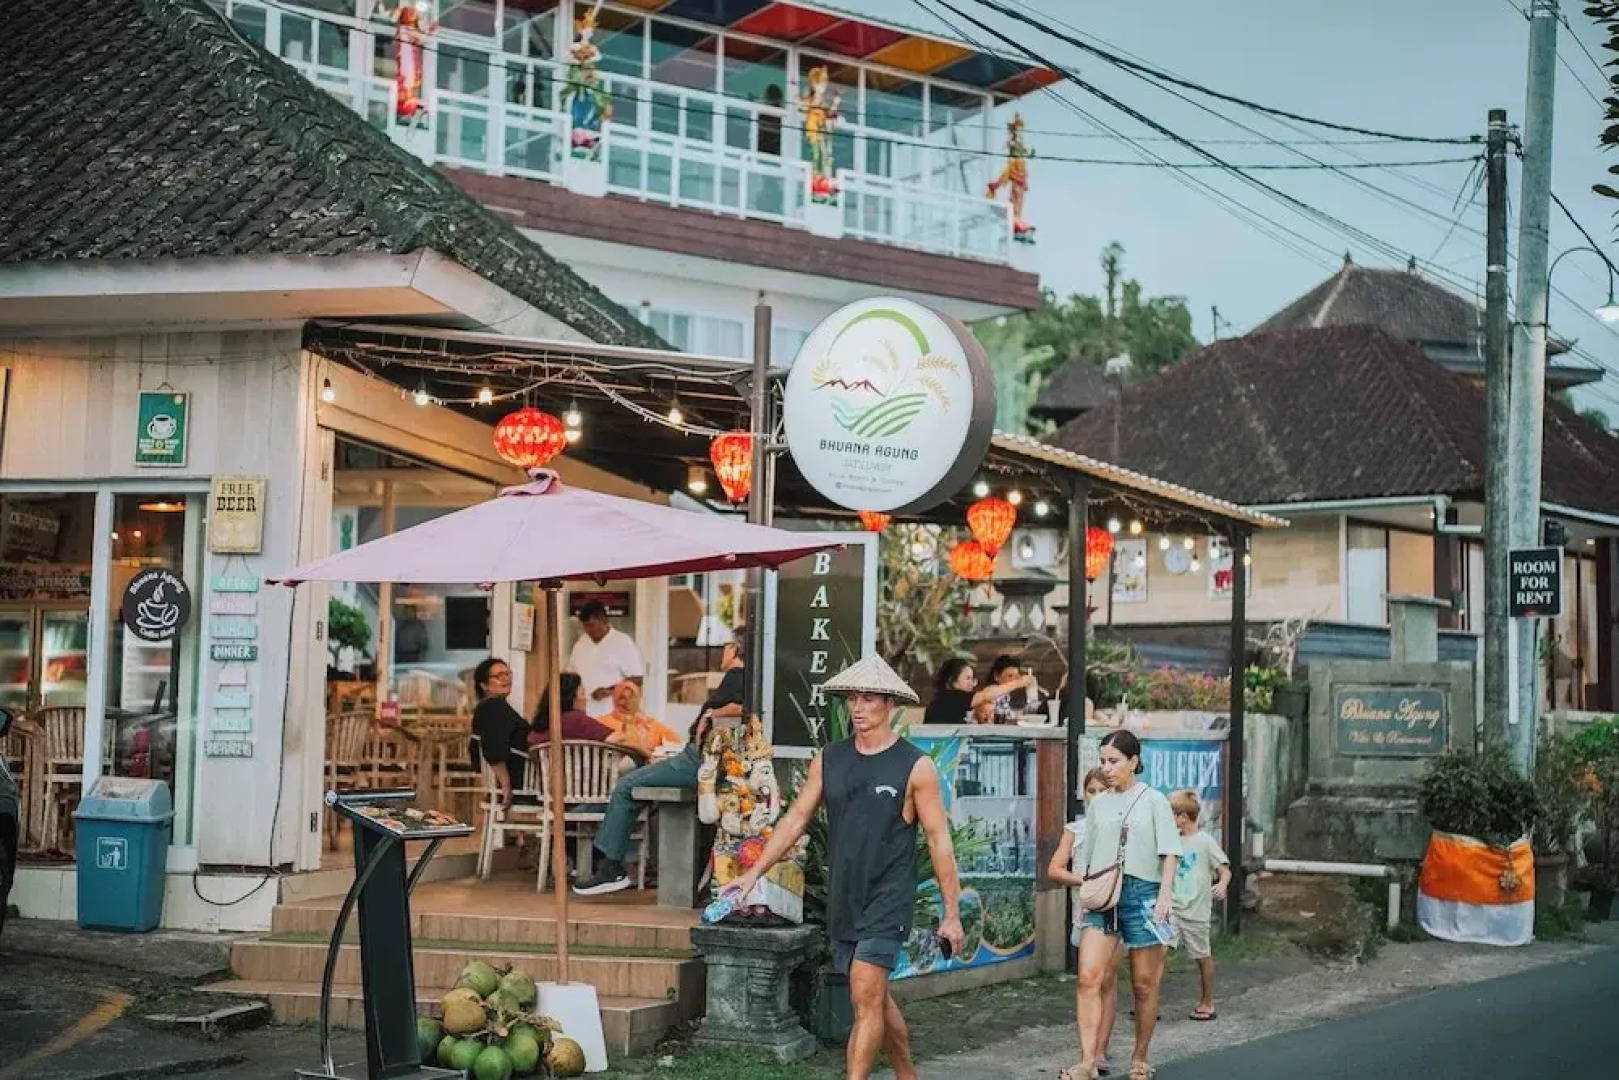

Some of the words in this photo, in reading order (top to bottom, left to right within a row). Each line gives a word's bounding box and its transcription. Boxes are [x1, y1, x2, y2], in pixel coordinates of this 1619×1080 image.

[819, 439, 870, 455] BHUANA
[875, 446, 919, 460] AGUNG
[221, 483, 255, 495] FREE
[216, 496, 257, 513] BEER
[1513, 561, 1557, 574] ROOM
[1521, 576, 1549, 589] FOR
[1516, 591, 1554, 605] RENT
[213, 645, 251, 659] DINNER
[808, 552, 831, 739] BAKERY
[1152, 751, 1219, 788] BUFFET
